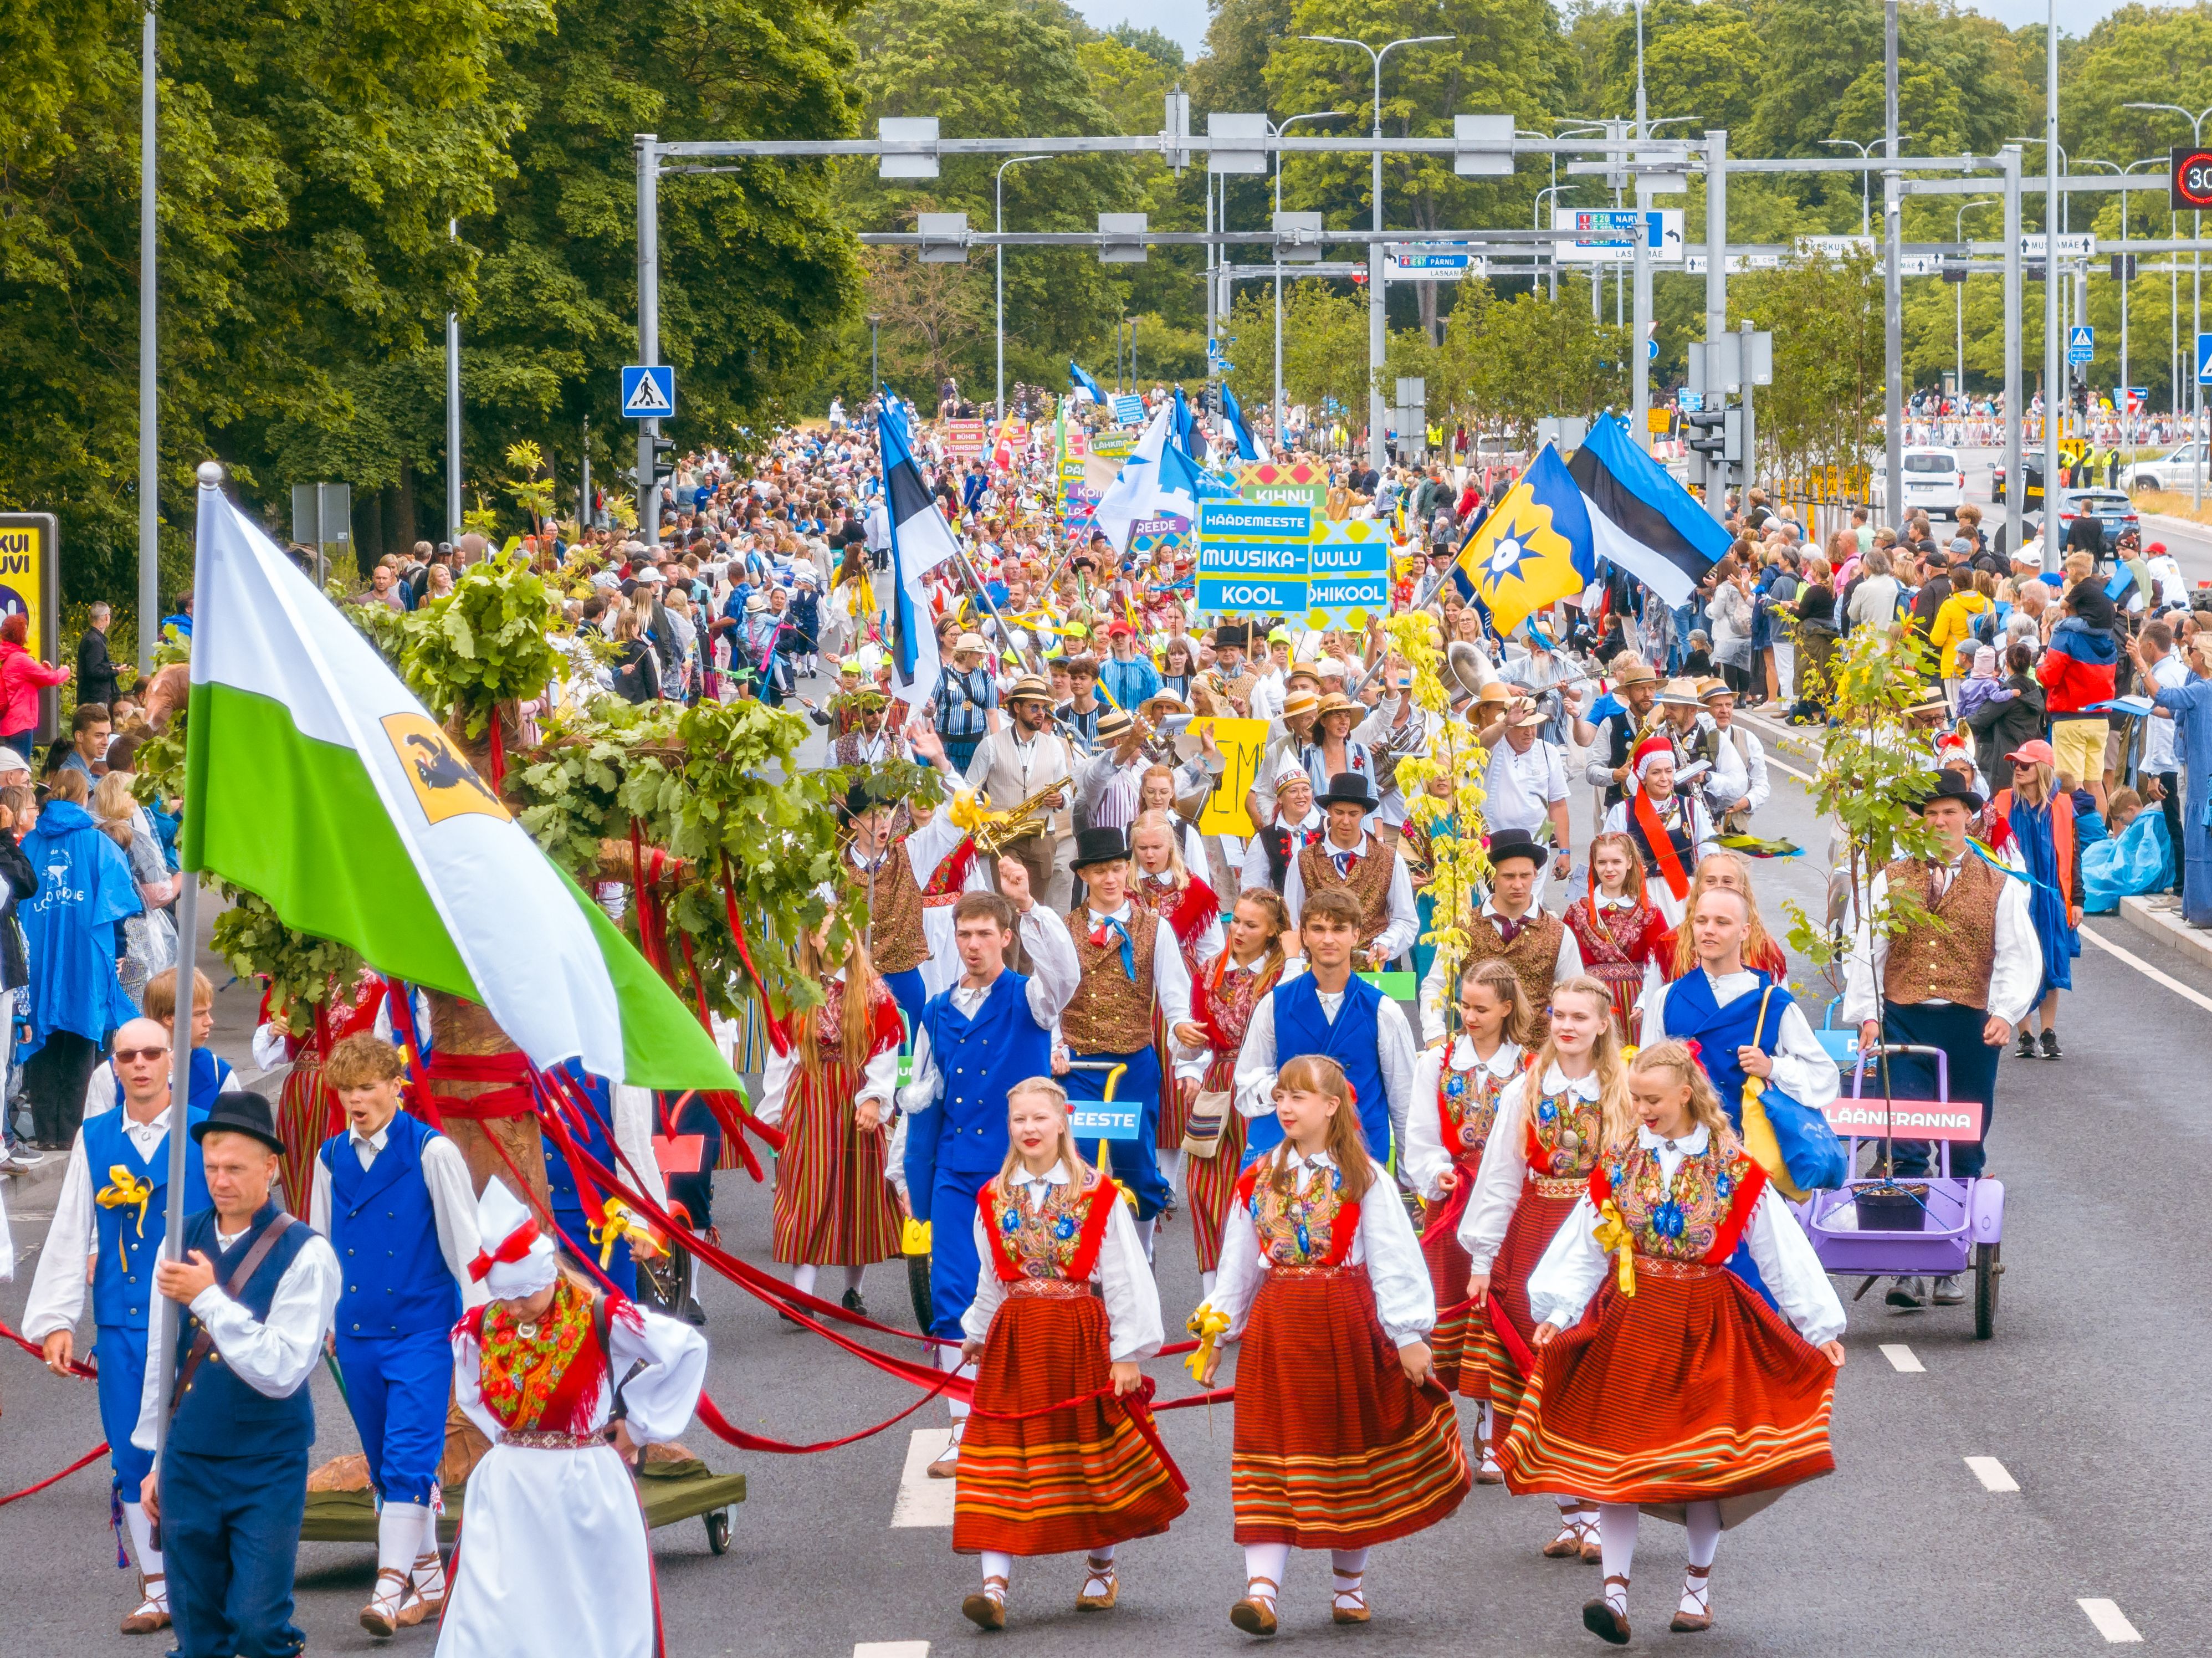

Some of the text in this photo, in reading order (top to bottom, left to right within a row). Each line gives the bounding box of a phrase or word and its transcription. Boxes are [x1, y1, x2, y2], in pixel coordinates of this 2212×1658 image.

[2189, 167, 2212, 188] 30
[1430, 257, 1455, 265] PÄRNU
[956, 432, 976, 441] RÜHM
[1256, 489, 1314, 502] KIHNU
[1206, 514, 1305, 528] HÄÄDEMEESTE
[1202, 549, 1305, 568] MUUSIKA-
[1314, 551, 1361, 567] UULU
[1222, 586, 1283, 605] KOOL
[1826, 1108, 1971, 1128] LÄÄNERANNA
